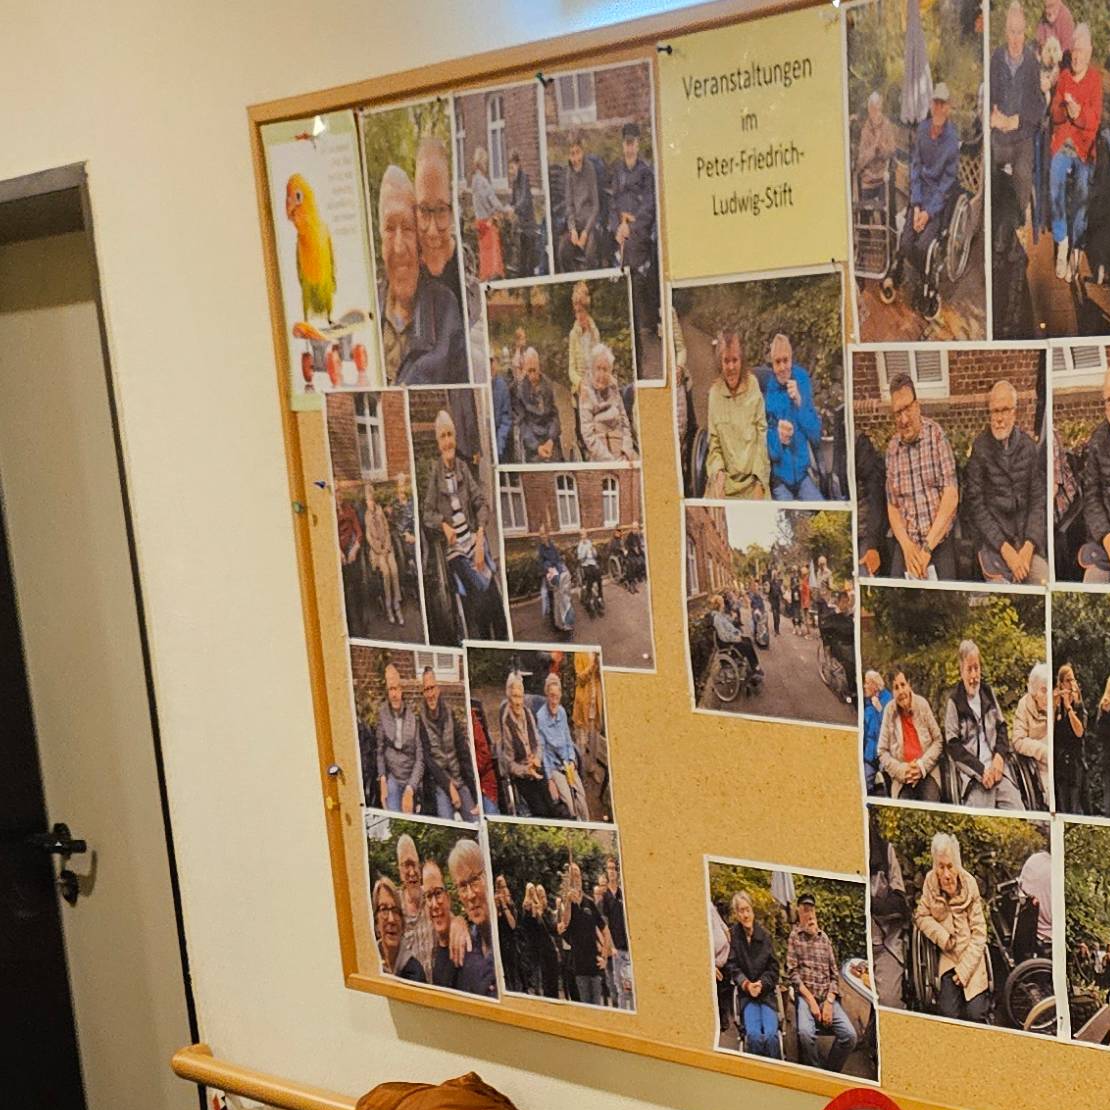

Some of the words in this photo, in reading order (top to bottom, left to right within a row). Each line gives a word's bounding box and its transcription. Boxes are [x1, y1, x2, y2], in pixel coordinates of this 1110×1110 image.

[682, 57, 813, 101] Veranstaltungen
[740, 110, 758, 131] im
[696, 140, 805, 178] Peter-Friedrich-
[711, 182, 794, 216] Ludwig-Stift
